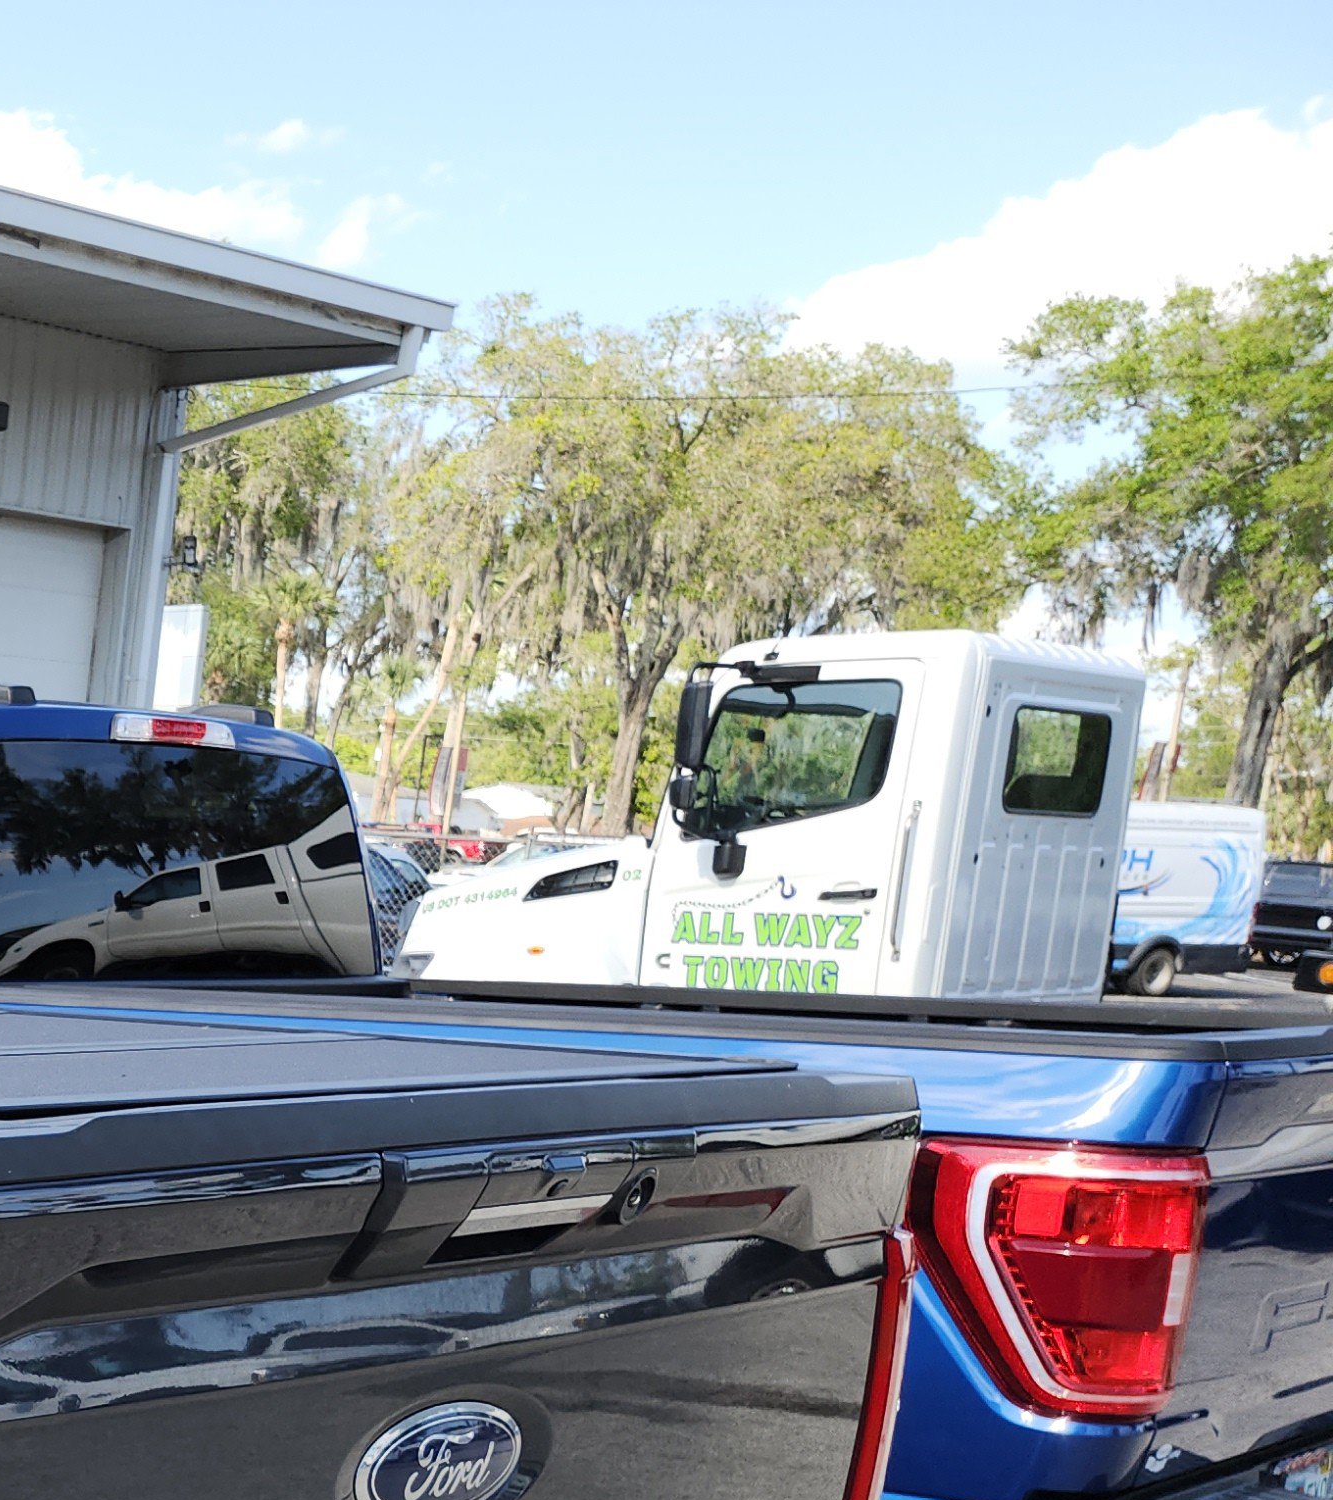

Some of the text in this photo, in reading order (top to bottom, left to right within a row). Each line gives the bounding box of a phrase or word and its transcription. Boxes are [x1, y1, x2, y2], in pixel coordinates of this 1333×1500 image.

[622, 869, 642, 881] 02
[437, 895, 460, 910] DOT
[672, 911, 862, 949] ALL WAYZ
[683, 955, 839, 994] TOWING
